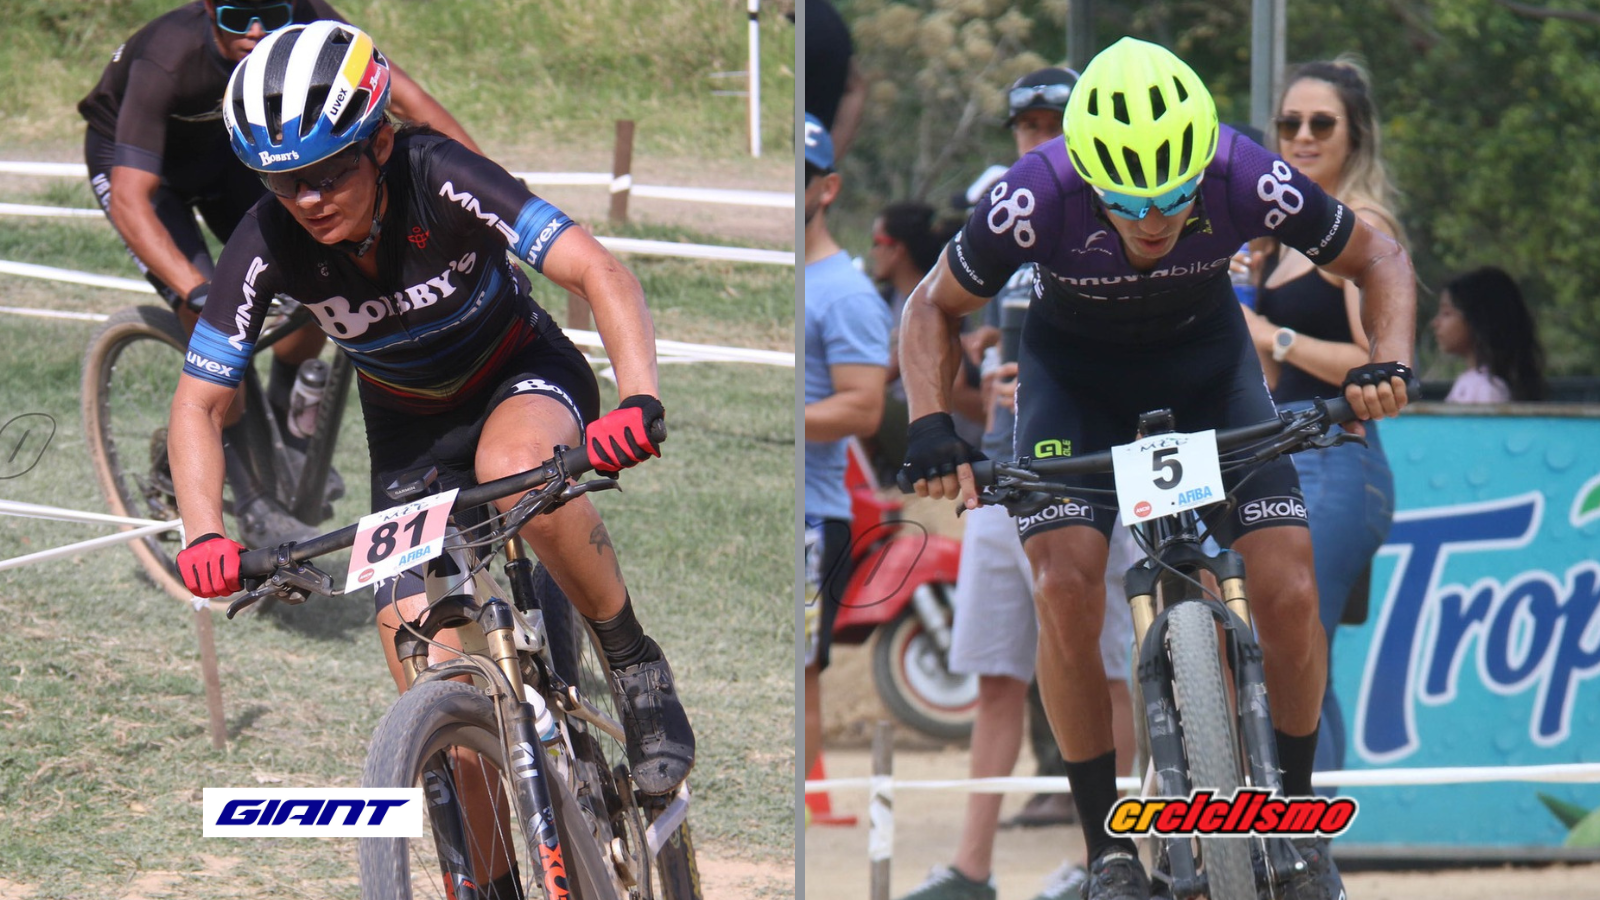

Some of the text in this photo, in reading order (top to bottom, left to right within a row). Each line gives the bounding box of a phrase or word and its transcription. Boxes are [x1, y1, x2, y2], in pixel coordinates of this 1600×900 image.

[330, 88, 348, 116] uvex
[438, 181, 520, 250] MMR
[1320, 204, 1344, 248] decavisa
[526, 218, 562, 265] uvex
[955, 244, 985, 286] decavisa
[228, 256, 270, 352] MMR
[186, 350, 234, 378] uvex
[1152, 447, 1183, 490] 5
[366, 509, 429, 565] 81
